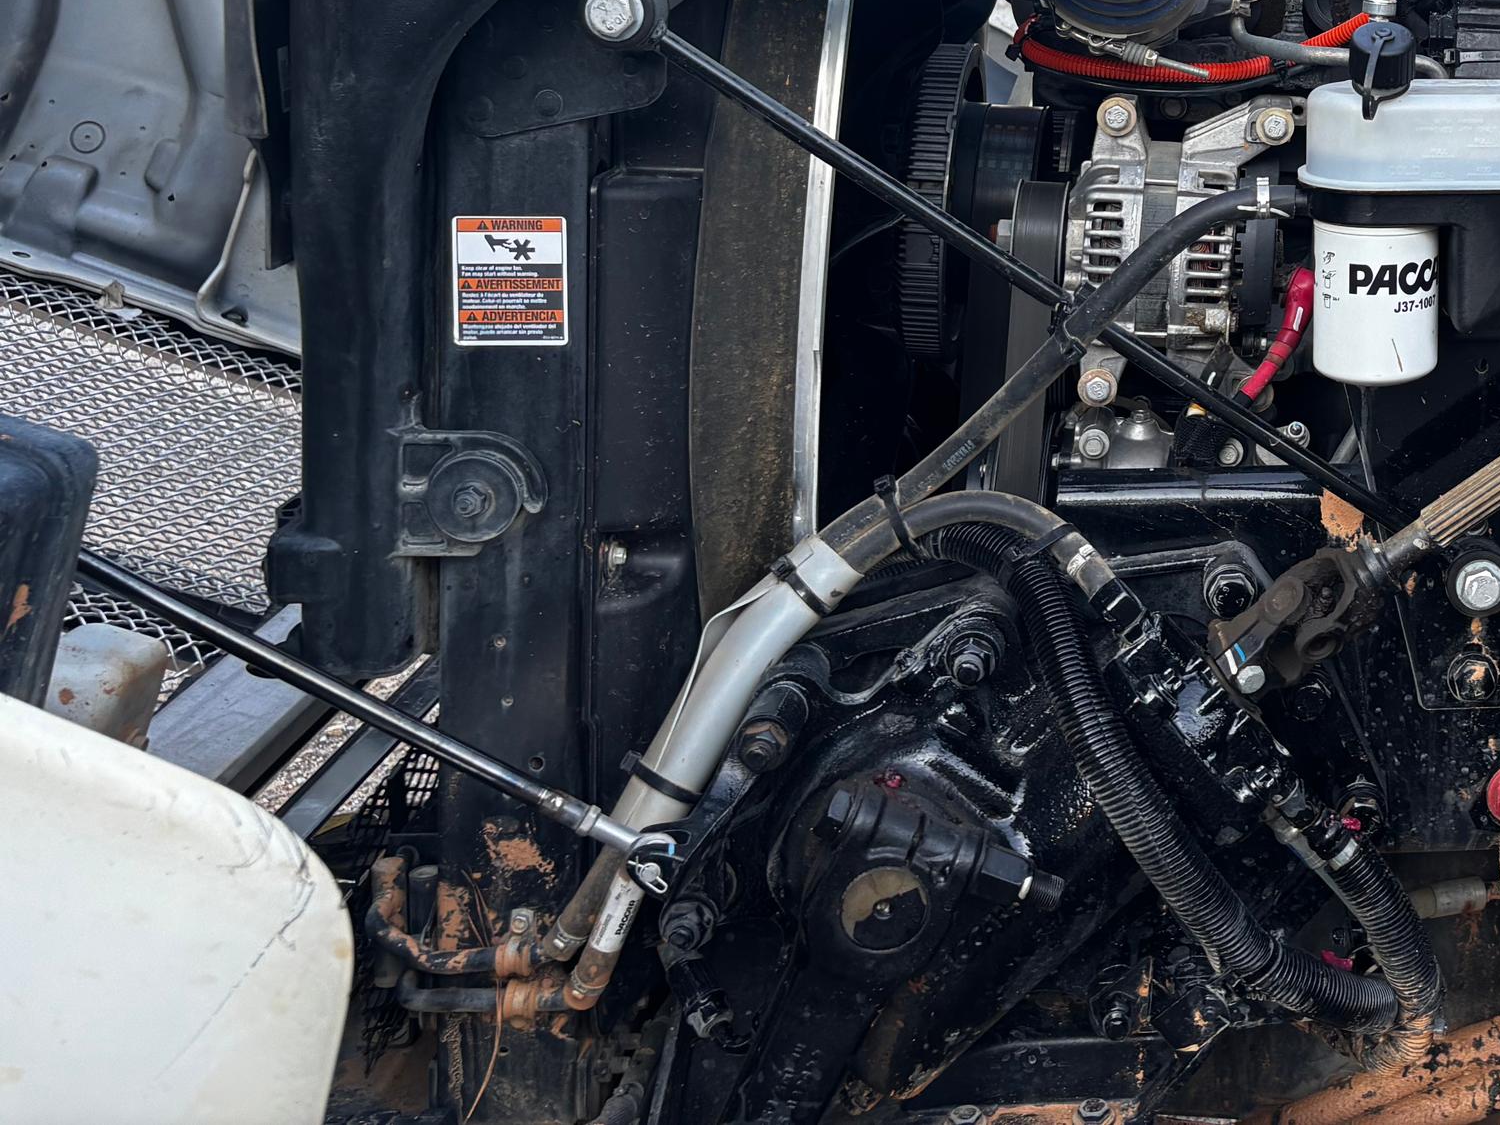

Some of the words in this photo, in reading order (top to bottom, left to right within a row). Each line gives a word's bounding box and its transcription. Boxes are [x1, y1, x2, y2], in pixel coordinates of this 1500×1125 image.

[491, 221, 542, 230] WARNING
[476, 280, 560, 289] AVERTISSEMENT
[482, 312, 556, 321] ADVERTENCIA
